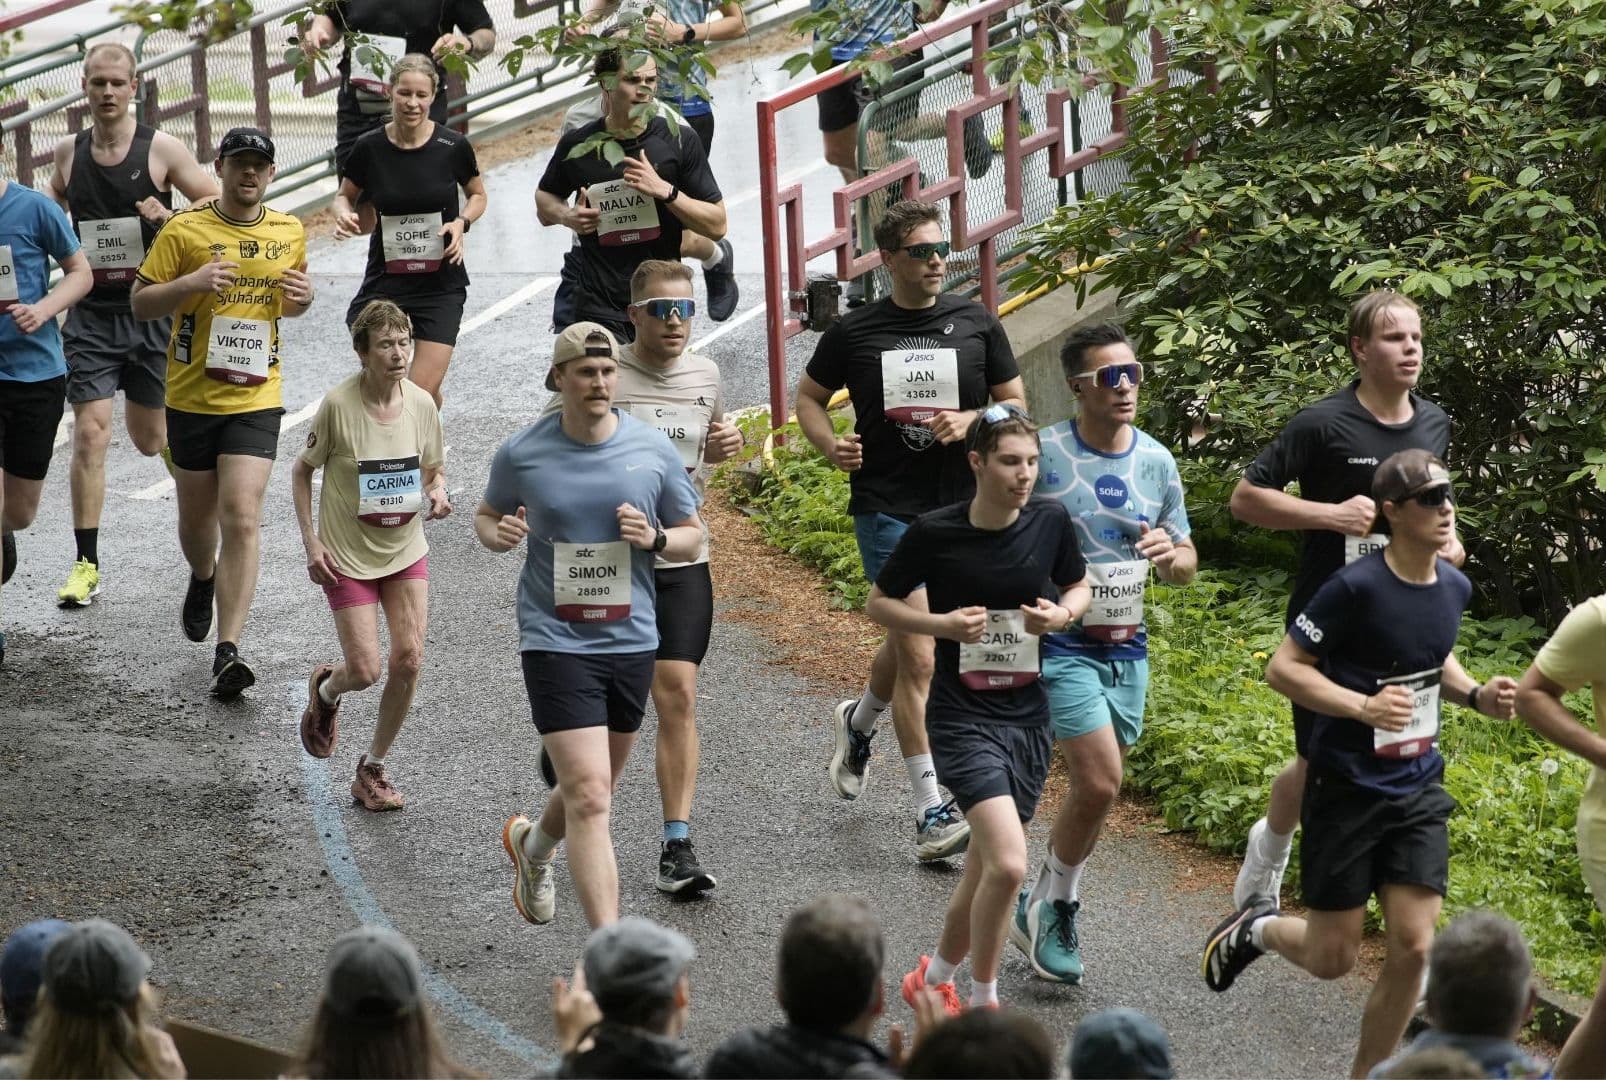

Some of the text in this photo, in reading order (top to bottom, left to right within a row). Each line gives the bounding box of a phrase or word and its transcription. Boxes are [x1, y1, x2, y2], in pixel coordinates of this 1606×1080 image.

[604, 184, 620, 194] stc
[600, 195, 645, 212] MALVA
[614, 215, 638, 225] 12719
[96, 223, 111, 231] stc
[395, 230, 431, 241] SOFIE
[97, 237, 127, 249] EMIL
[100, 253, 127, 263] 55252
[216, 291, 273, 306] Sjuhärad
[239, 323, 257, 331] asics
[216, 334, 263, 351] VIKTOR
[227, 355, 251, 365] 31122
[914, 353, 935, 362] asics
[906, 370, 935, 383] JAN
[905, 389, 937, 399] 43628
[1347, 457, 1372, 465] CRAFT
[379, 463, 406, 471] Polestar
[367, 475, 415, 491] CARINA
[1098, 487, 1124, 497] solar
[380, 495, 404, 506] 61310
[575, 547, 596, 558] stc
[568, 565, 617, 579] SIMON
[1116, 567, 1134, 576] asics
[576, 586, 610, 597] 28890
[1089, 582, 1143, 599] THOMAS
[980, 632, 1022, 645] CARL
[984, 653, 1017, 663] 22077
